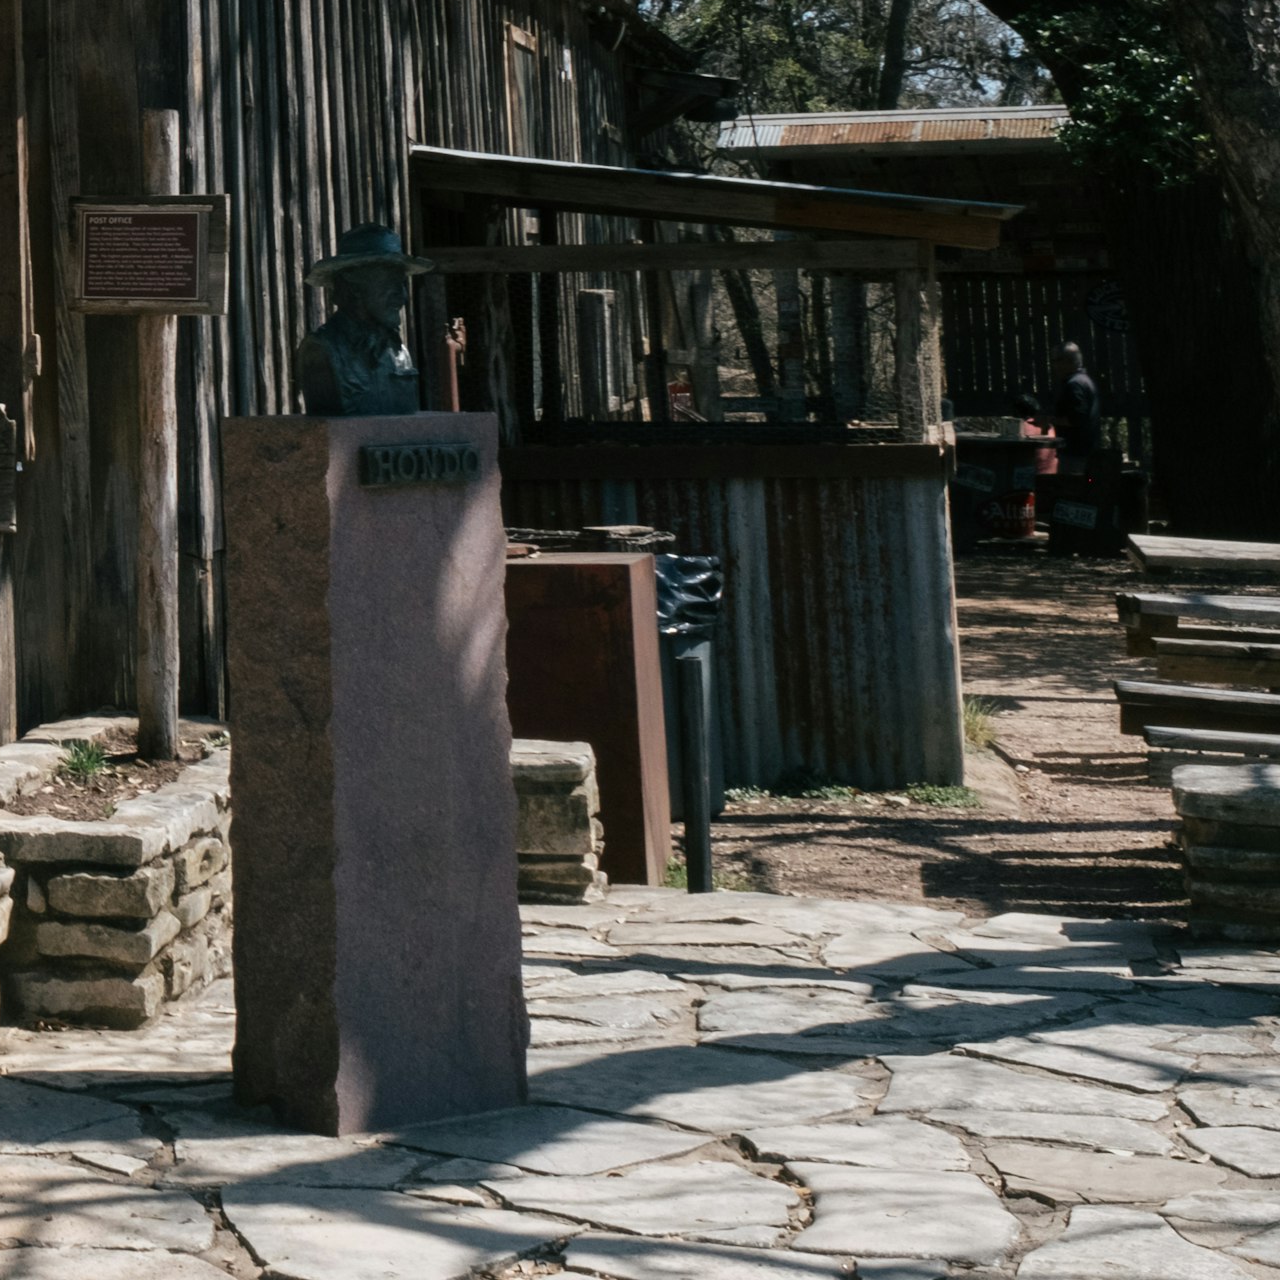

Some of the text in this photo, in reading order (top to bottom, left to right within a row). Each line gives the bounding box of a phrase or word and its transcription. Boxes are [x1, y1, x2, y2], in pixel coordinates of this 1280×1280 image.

[88, 216, 133, 225] POST OFFICE
[373, 447, 480, 483] HONDO
